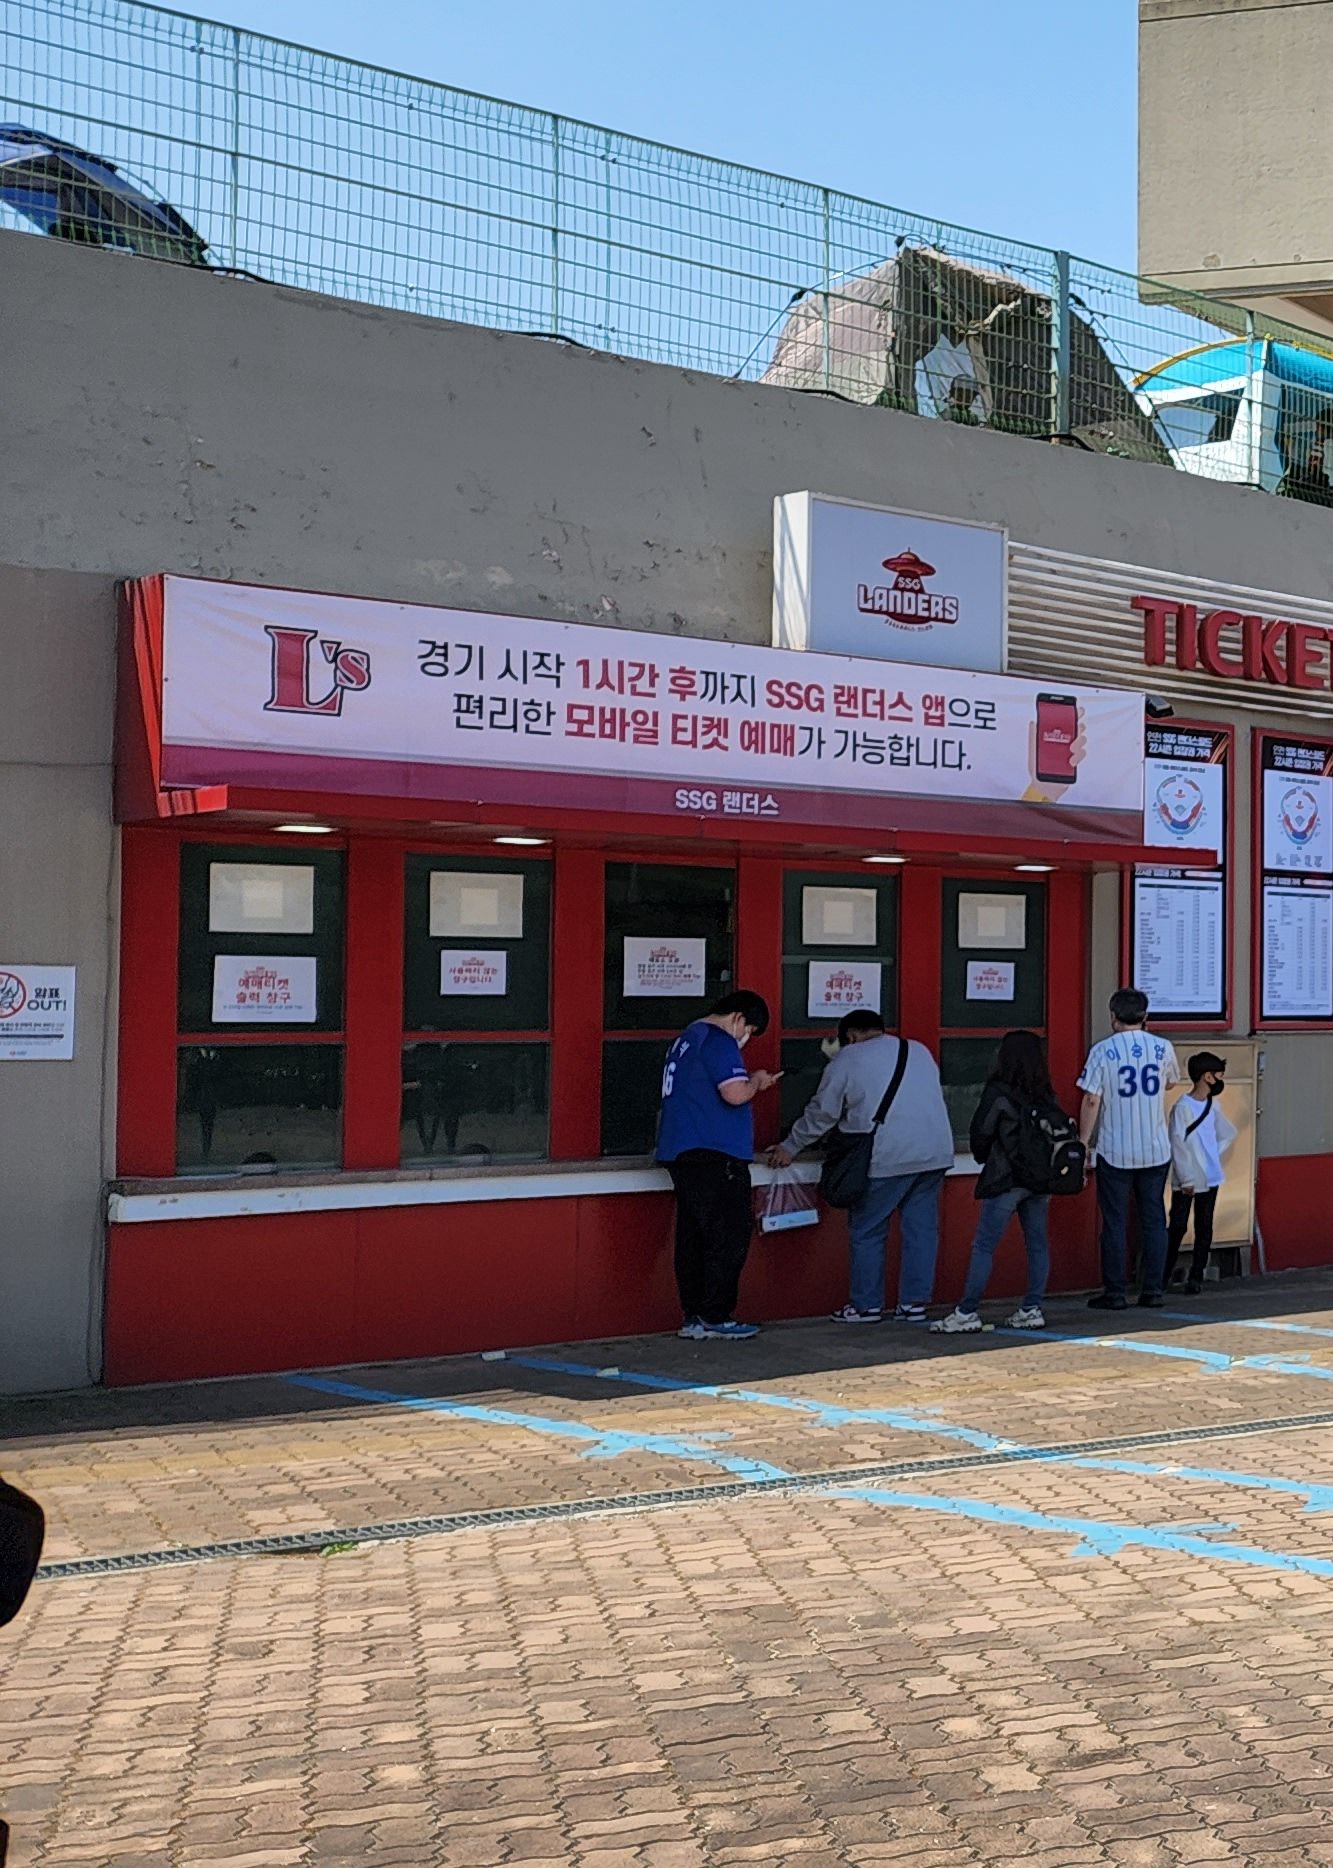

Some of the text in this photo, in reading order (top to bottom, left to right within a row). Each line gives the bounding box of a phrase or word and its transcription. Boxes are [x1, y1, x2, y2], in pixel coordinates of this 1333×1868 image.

[897, 576, 921, 591] SSG
[858, 584, 959, 623] LANDERS
[417, 639, 998, 731] 경기 시작 1시간 후까지 SSG 랜더스 앱으로
[453, 692, 972, 770] 편리한 모바일 티켓 예매가 가능합니다.
[674, 788, 780, 816] SSG 랜더스
[27, 1000, 67, 1012] OUT!
[1117, 1063, 1160, 1098] 36
